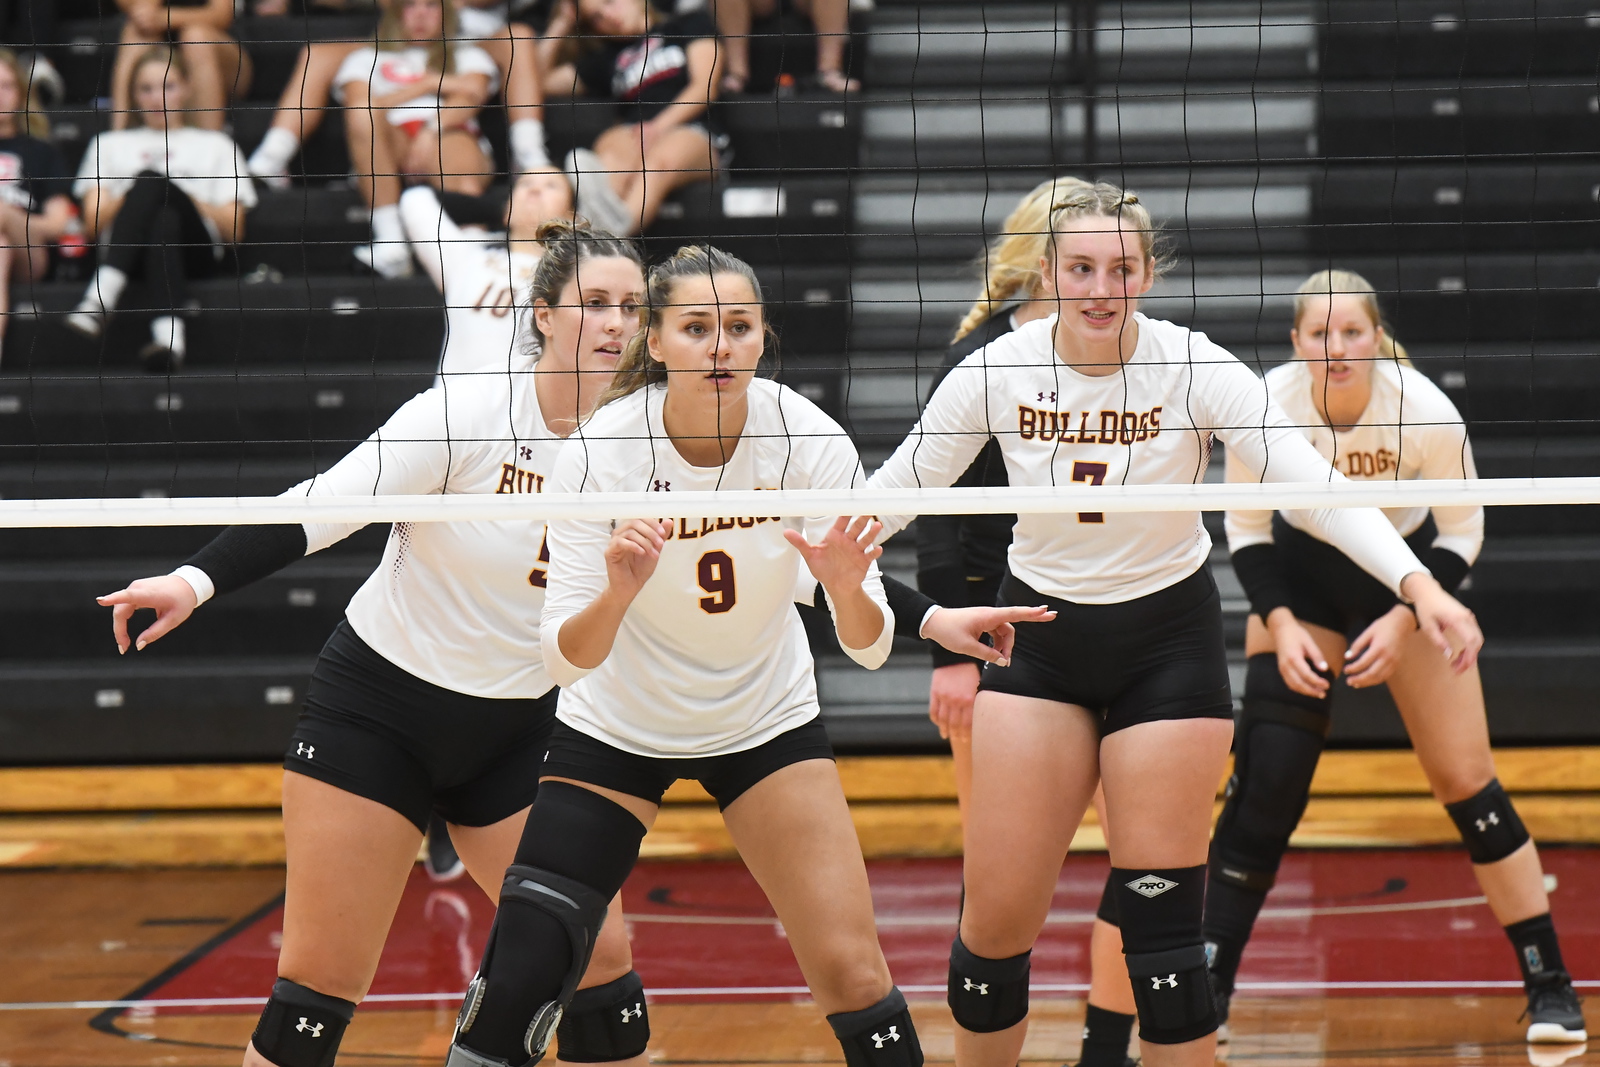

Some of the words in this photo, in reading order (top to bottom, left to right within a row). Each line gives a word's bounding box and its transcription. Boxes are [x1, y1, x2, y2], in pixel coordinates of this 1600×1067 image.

[473, 281, 518, 319] 10
[1018, 405, 1163, 445] BULLDOGS
[696, 549, 738, 615] 9
